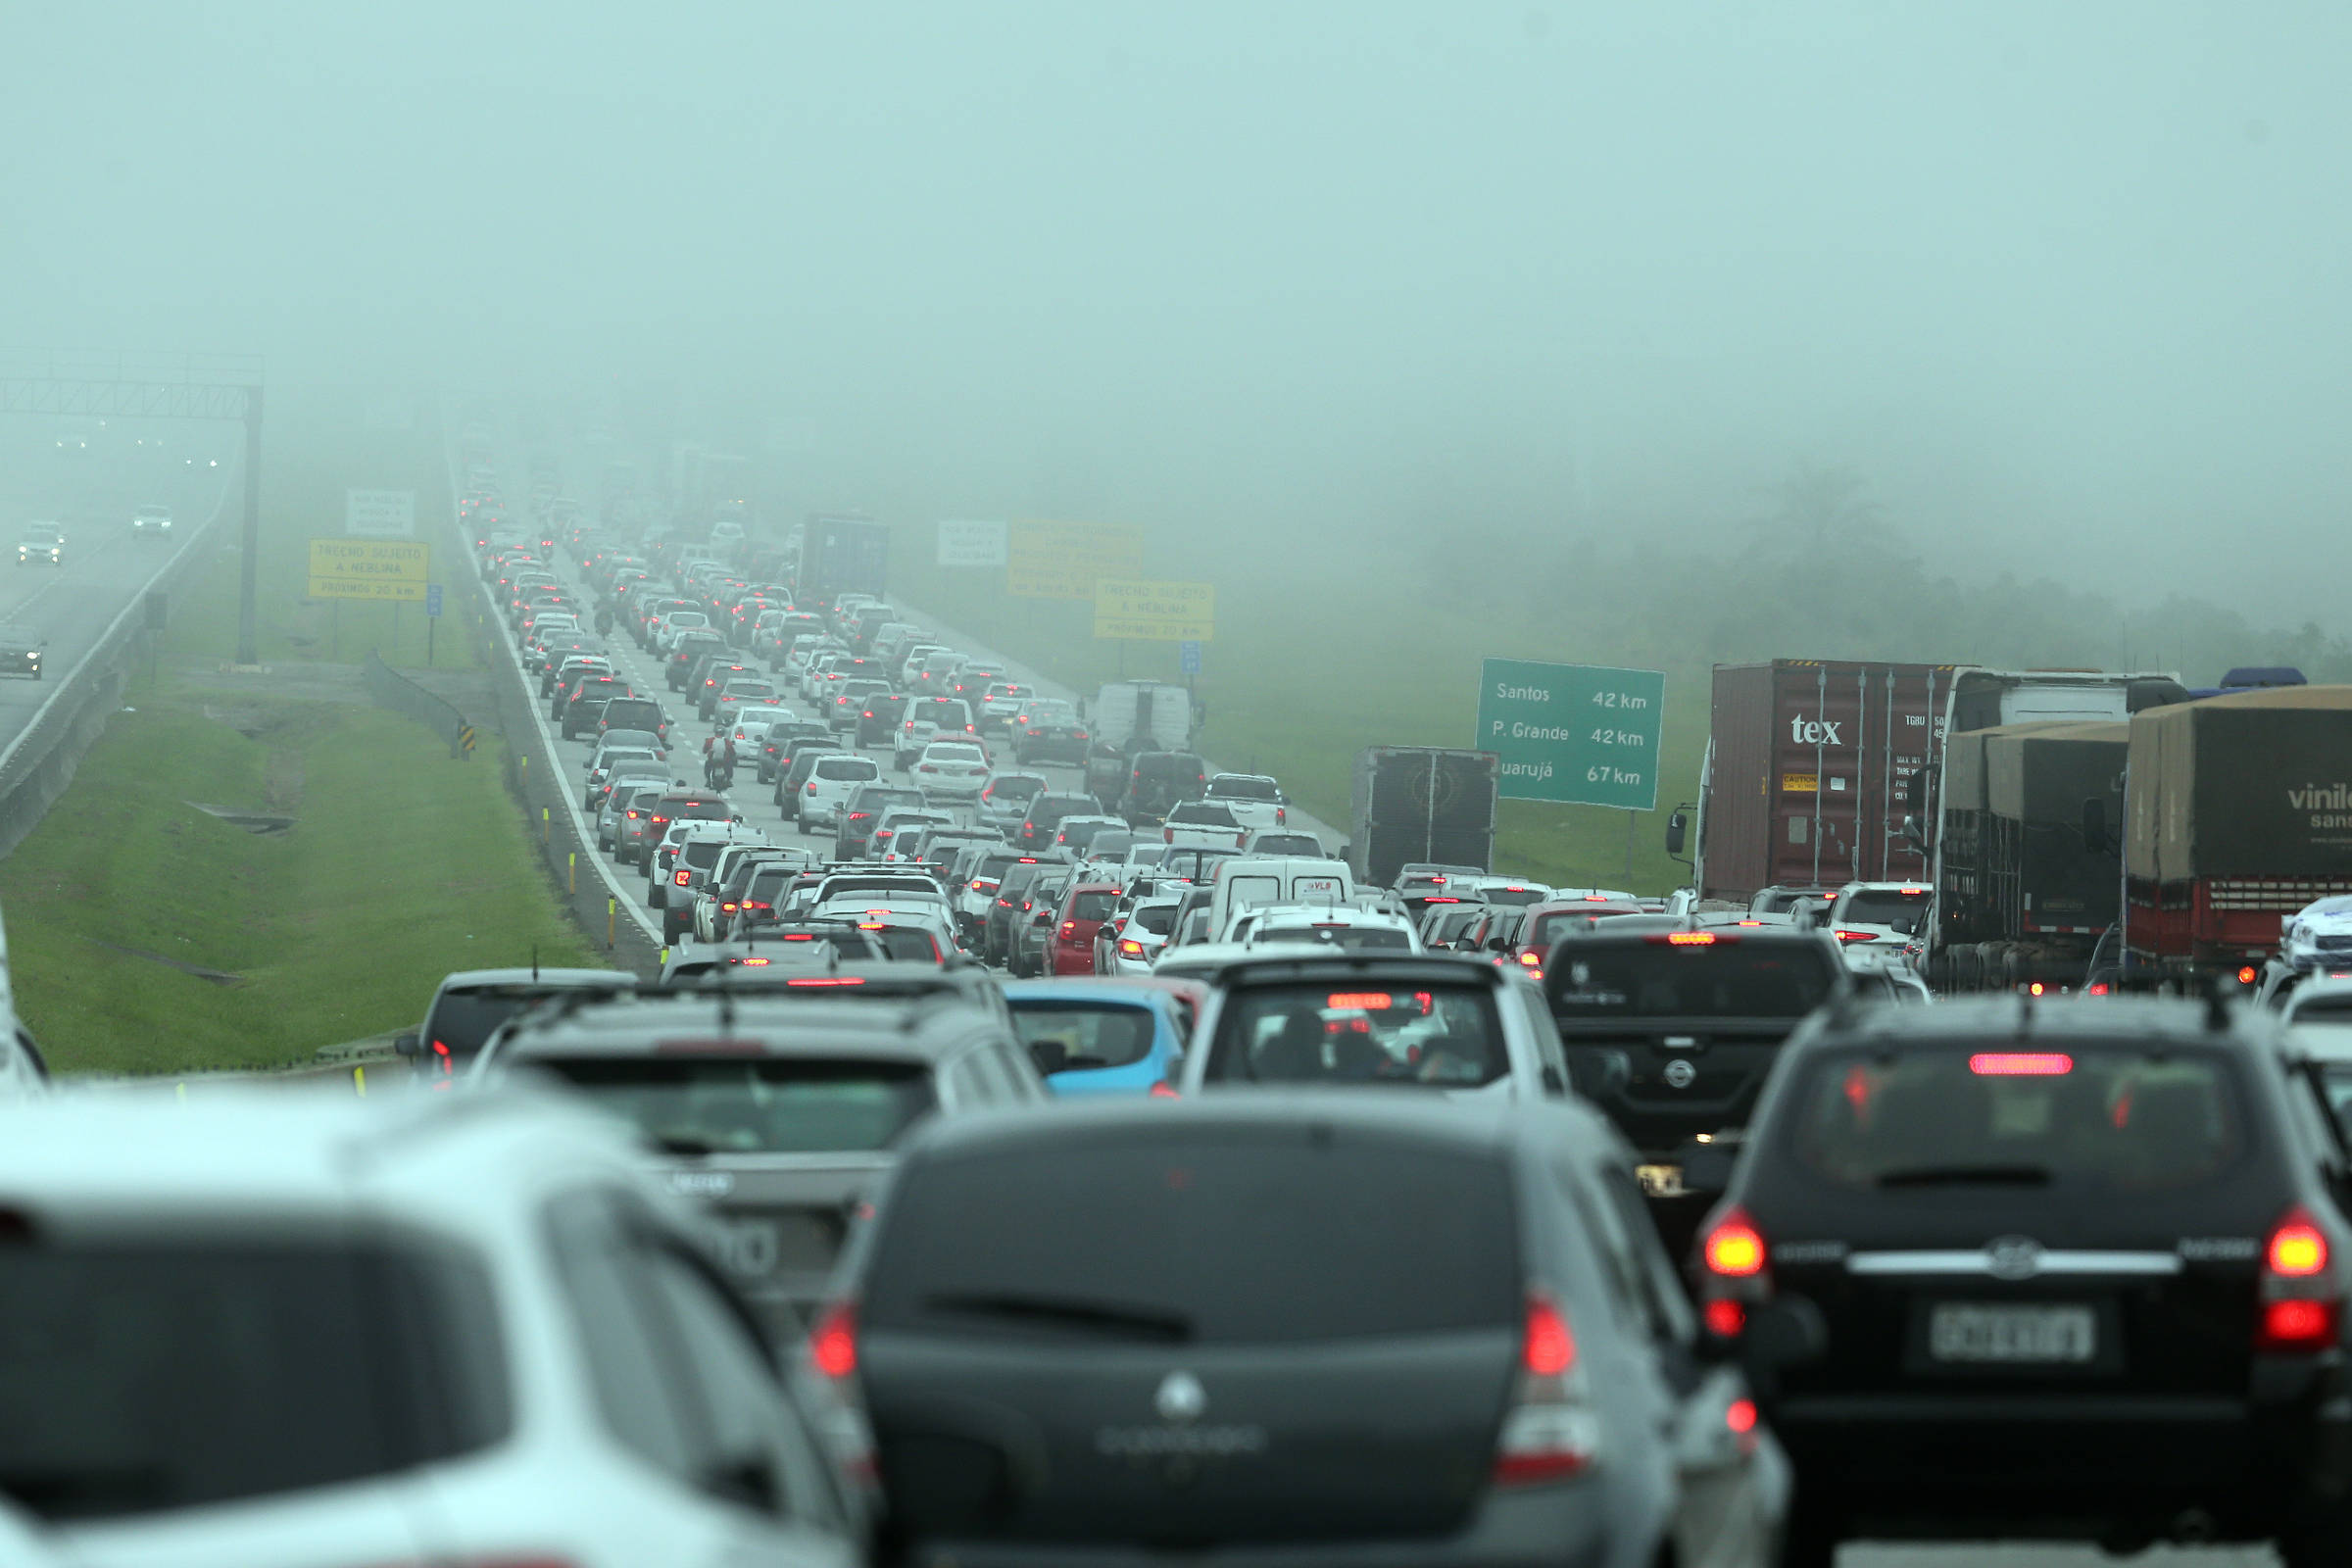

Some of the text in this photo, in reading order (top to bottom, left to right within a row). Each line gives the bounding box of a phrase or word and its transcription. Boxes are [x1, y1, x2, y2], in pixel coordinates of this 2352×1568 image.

[318, 545, 364, 558] TRECHO
[351, 563, 403, 574] NEBLINA
[1496, 682, 1647, 710] Santos 42 km
[1791, 713, 1842, 745] tex
[1935, 715, 1944, 727] 50
[1493, 720, 1644, 747] P. Grande 42 km
[1934, 728, 1944, 739] 45
[1501, 761, 1641, 785] uarujá 67 km
[2287, 782, 2352, 809] vinil
